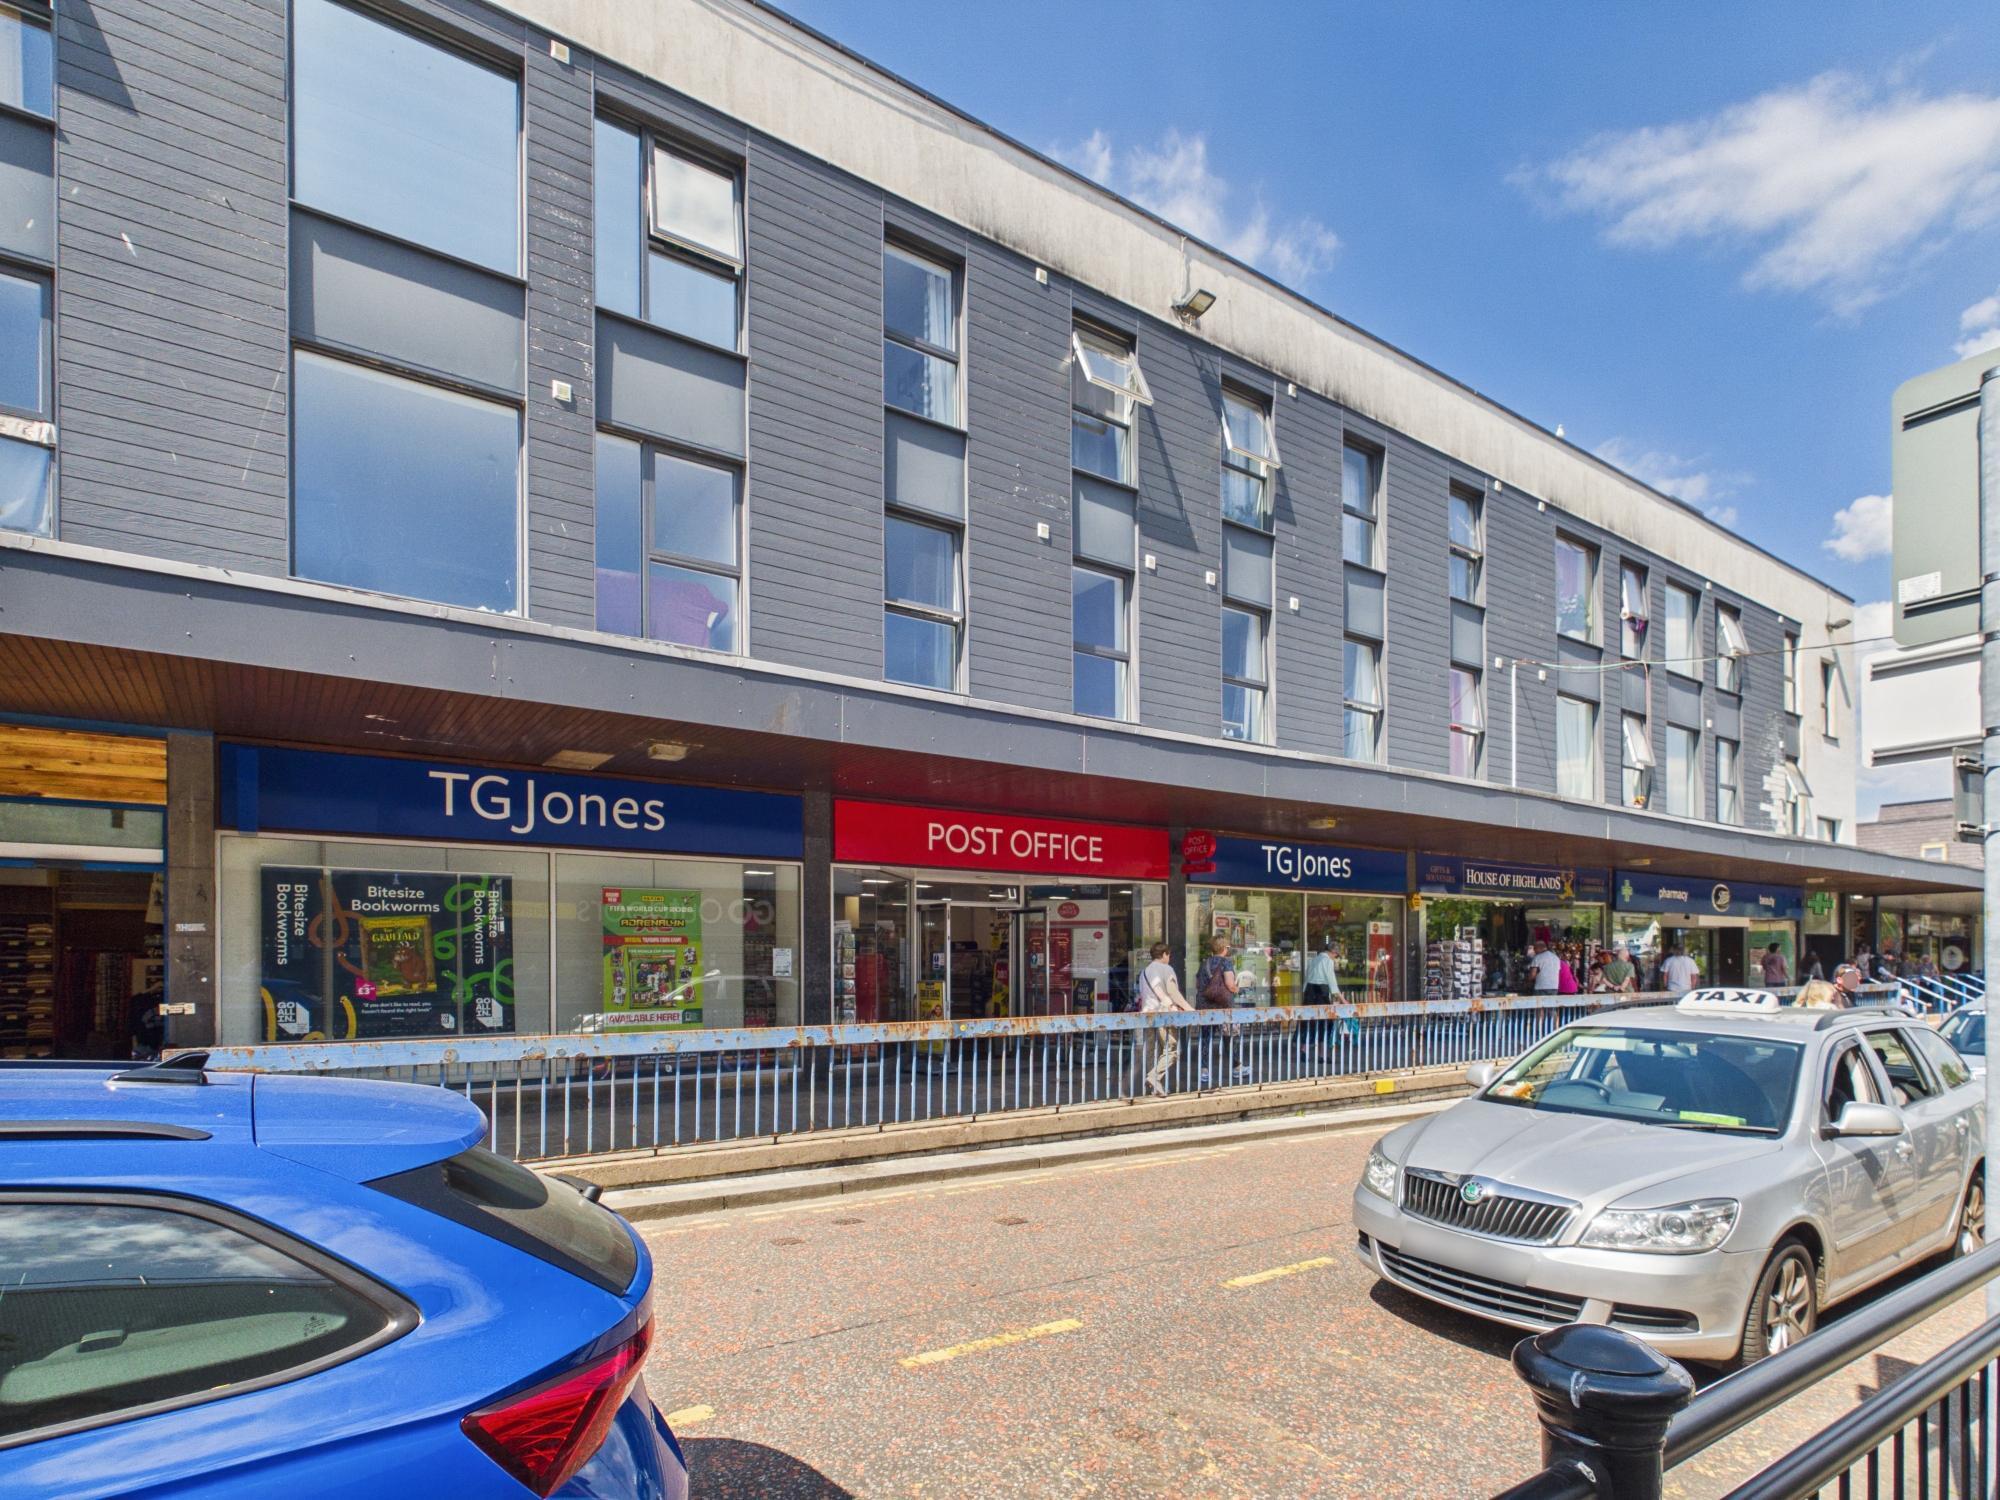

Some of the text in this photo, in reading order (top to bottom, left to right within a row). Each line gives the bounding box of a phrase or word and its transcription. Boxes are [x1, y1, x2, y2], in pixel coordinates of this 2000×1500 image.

[428, 770, 666, 834] TGJones
[928, 822, 1103, 863] POST OFFICE
[1184, 844, 1209, 856] OFFICE
[1188, 835, 1205, 844] POST
[1261, 845, 1351, 882] TGJones
[1466, 868, 1561, 890] HOUSE OF HIGHLANDS
[367, 886, 425, 899] Bitesize
[1658, 887, 1688, 902] pharmacy
[294, 884, 308, 936] Bitesize
[351, 899, 440, 913] Bookworms
[488, 890, 499, 938] Bitesize
[277, 883, 291, 965] Bookworms
[473, 890, 486, 965] Bookworms
[1694, 991, 1767, 1004] TAXI
[609, 1012, 680, 1023] AVAILABLE HERE!
